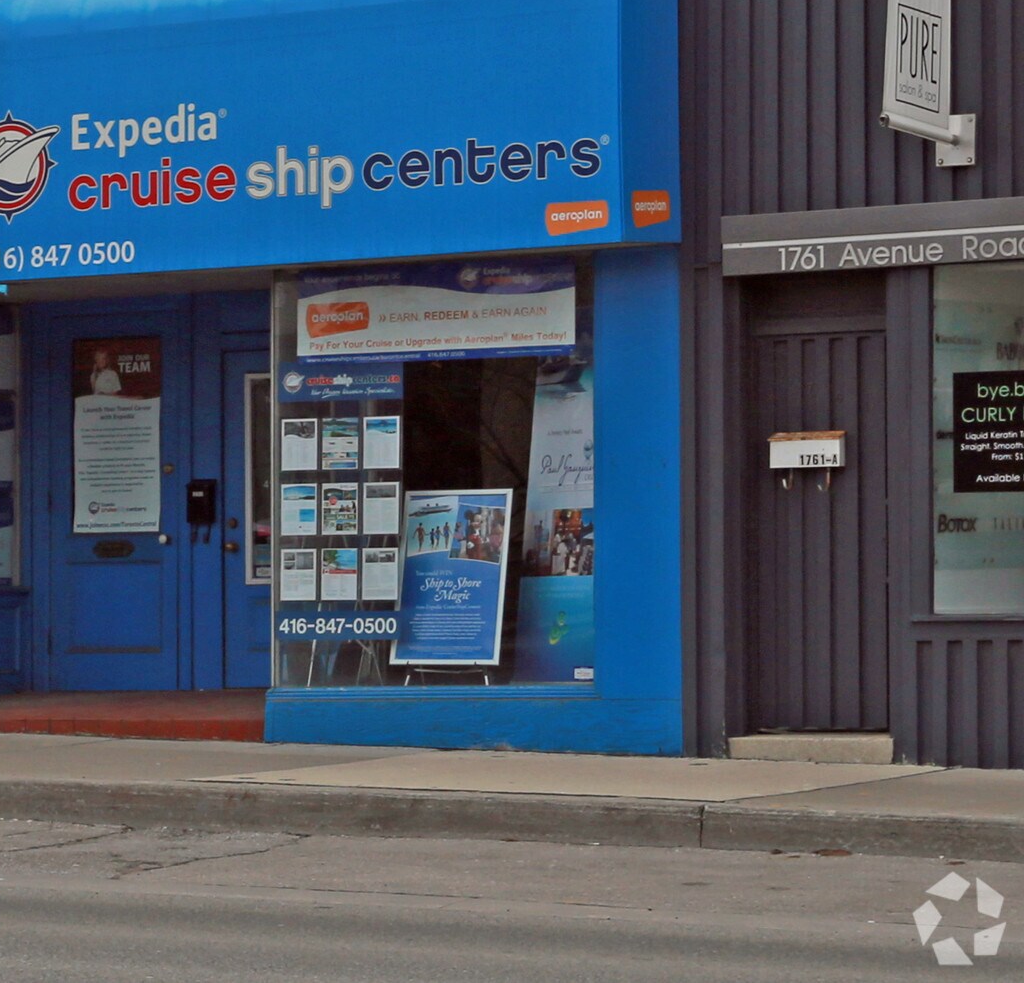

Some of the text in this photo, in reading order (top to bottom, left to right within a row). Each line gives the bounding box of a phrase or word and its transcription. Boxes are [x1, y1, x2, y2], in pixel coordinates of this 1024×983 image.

[899, 12, 938, 84] PURE
[68, 157, 238, 213] cruise
[245, 144, 355, 210] ship
[634, 199, 668, 215] aeroplan
[550, 208, 604, 223] aeroplan
[30, 243, 72, 268] 847
[78, 240, 136, 266] 0500
[778, 244, 826, 271] 1761
[838, 241, 945, 267] Avenue
[424, 309, 469, 321] REDEEM
[482, 307, 511, 318] EARN
[513, 305, 548, 317] AGAIN
[309, 341, 323, 352] Pay
[326, 340, 341, 350] For
[342, 339, 363, 350] Your
[365, 338, 393, 349] Cruise
[394, 338, 405, 347] or
[405, 335, 442, 348] Upgrade
[444, 334, 463, 345] with
[511, 331, 534, 342] Miles
[118, 361, 151, 373] TEAM
[961, 406, 1017, 424] CURLY
[965, 431, 989, 442] Liquid
[989, 430, 1018, 440] Keratin
[799, 453, 839, 466] 1761-A
[976, 472, 1021, 484] Available
[420, 576, 482, 591] Ship to Shore
[433, 589, 471, 604] Magic
[278, 616, 398, 635] 416-847-0500
